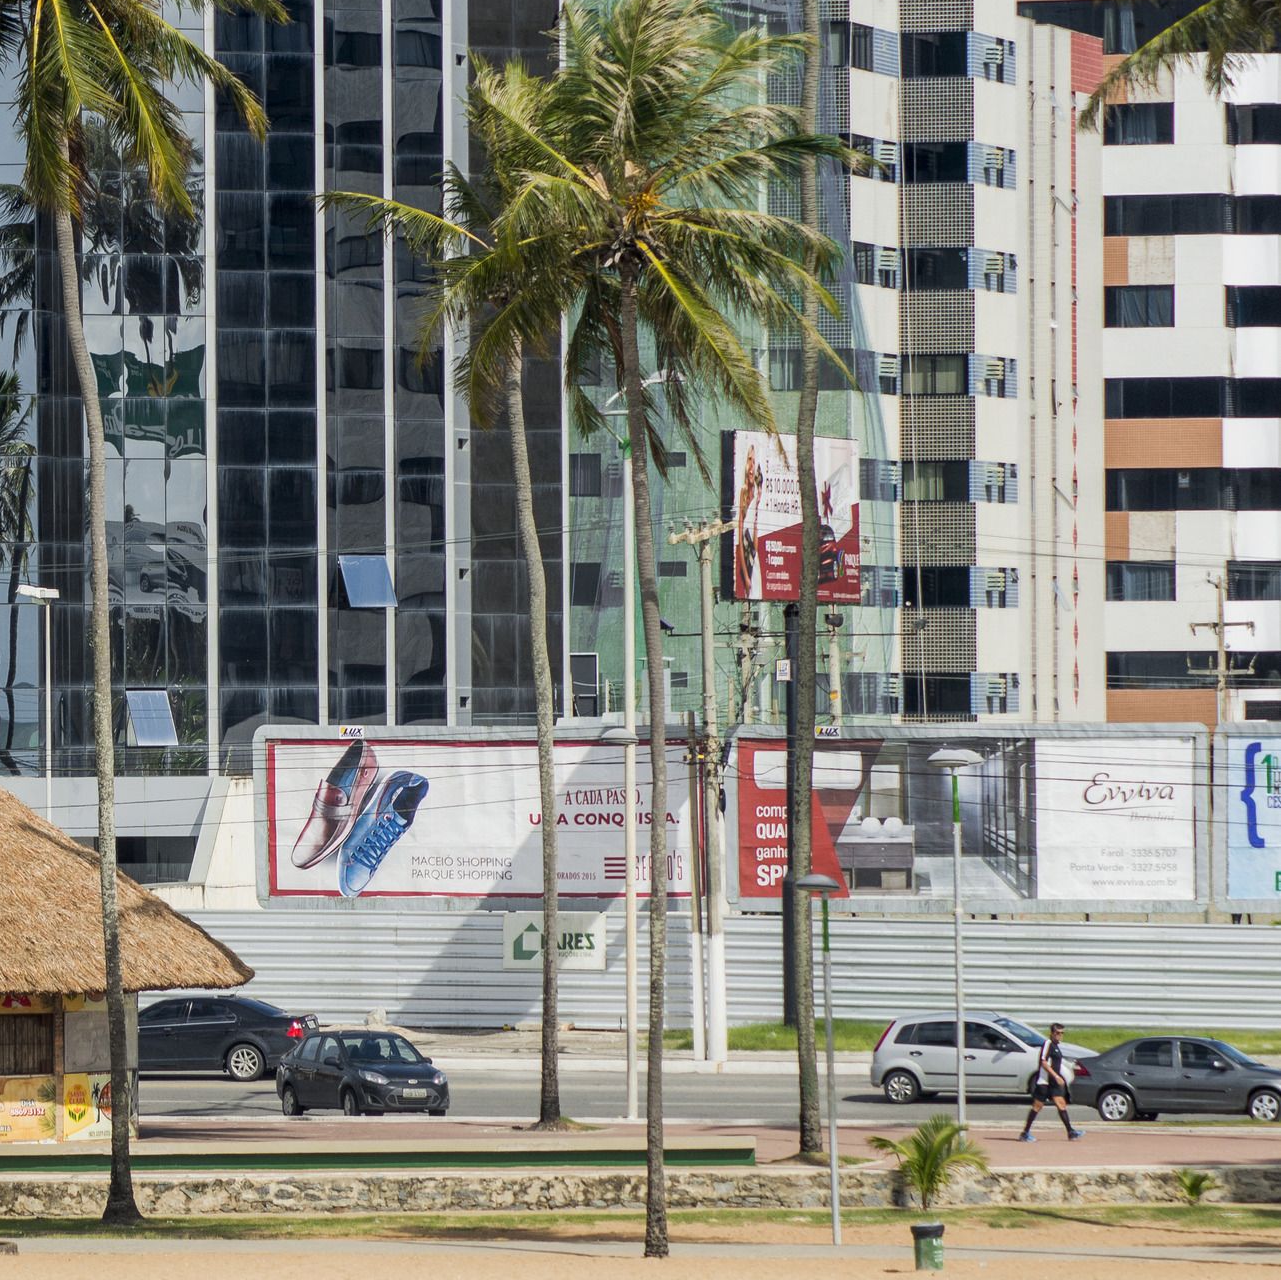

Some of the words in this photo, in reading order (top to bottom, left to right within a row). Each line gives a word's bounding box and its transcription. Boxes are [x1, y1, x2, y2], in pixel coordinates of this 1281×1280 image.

[343, 727, 363, 735] LUX
[820, 727, 839, 735] LUX
[1083, 772, 1175, 805] Evviva
[564, 790, 573, 805] A
[575, 789, 604, 805] CADA
[606, 789, 644, 806] PASO,
[529, 812, 569, 826] UA
[573, 812, 680, 827] CONQISA.
[1101, 848, 1124, 857] Farol
[411, 854, 454, 866] MACEIÓ
[456, 856, 512, 867] SHOPPING
[1070, 863, 1095, 871] Ponta
[1097, 863, 1124, 871] Verde
[411, 869, 454, 880] PARQUE
[457, 870, 513, 881] SHOPPING
[581, 871, 597, 880] 2015
